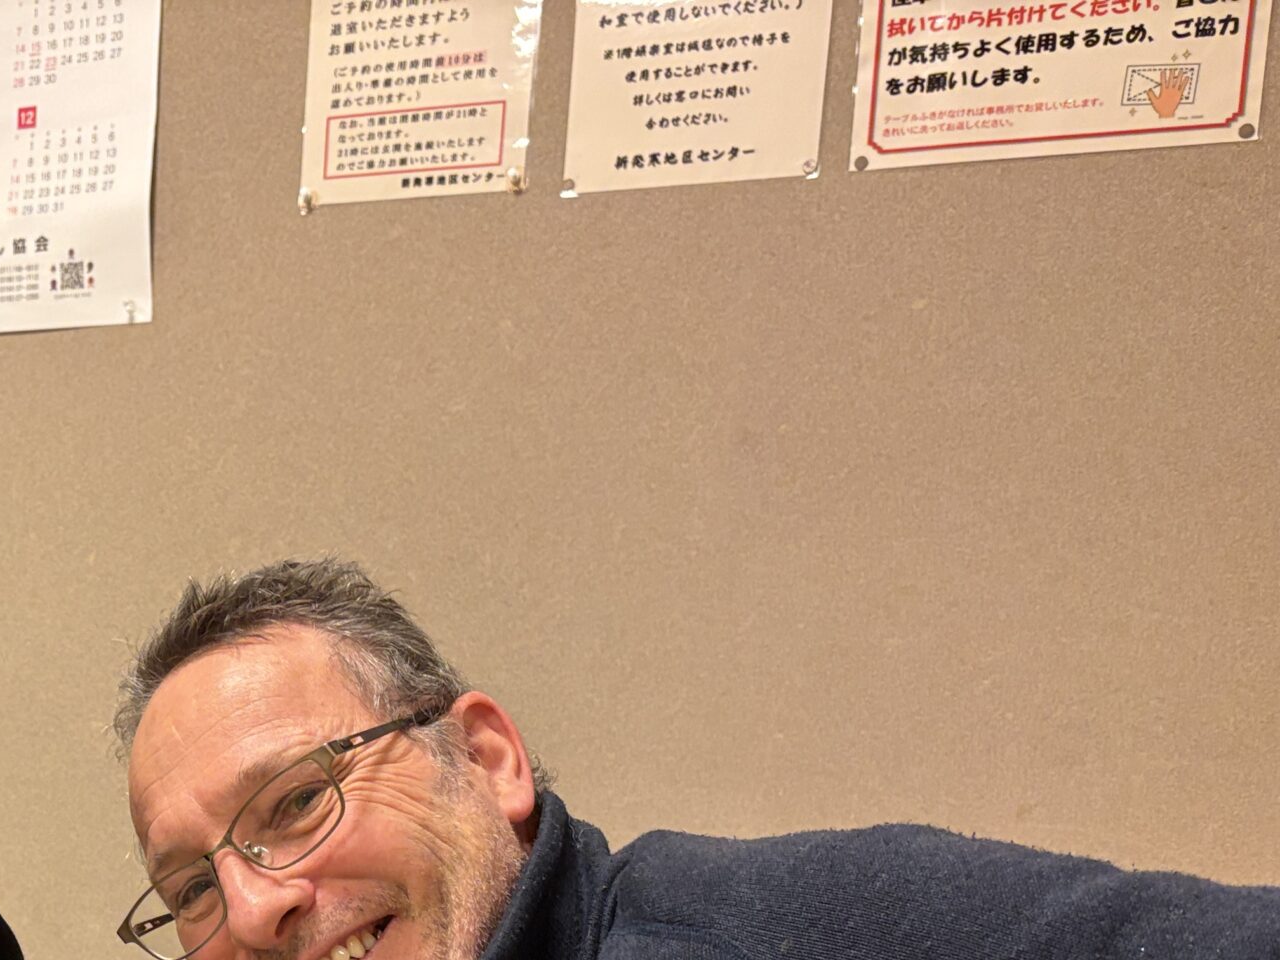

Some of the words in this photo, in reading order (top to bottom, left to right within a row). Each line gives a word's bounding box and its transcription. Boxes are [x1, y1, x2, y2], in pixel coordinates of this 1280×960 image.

[330, 8, 470, 36] 退室いただきますよう
[328, 32, 449, 56] お願いいたします。
[625, 60, 759, 83] 使用することができます。
[885, 65, 1040, 96] をお願いします。
[633, 86, 752, 107] 詳しくは窓口にお問い
[20, 111, 34, 126] 12
[646, 113, 729, 130] 合わせください。
